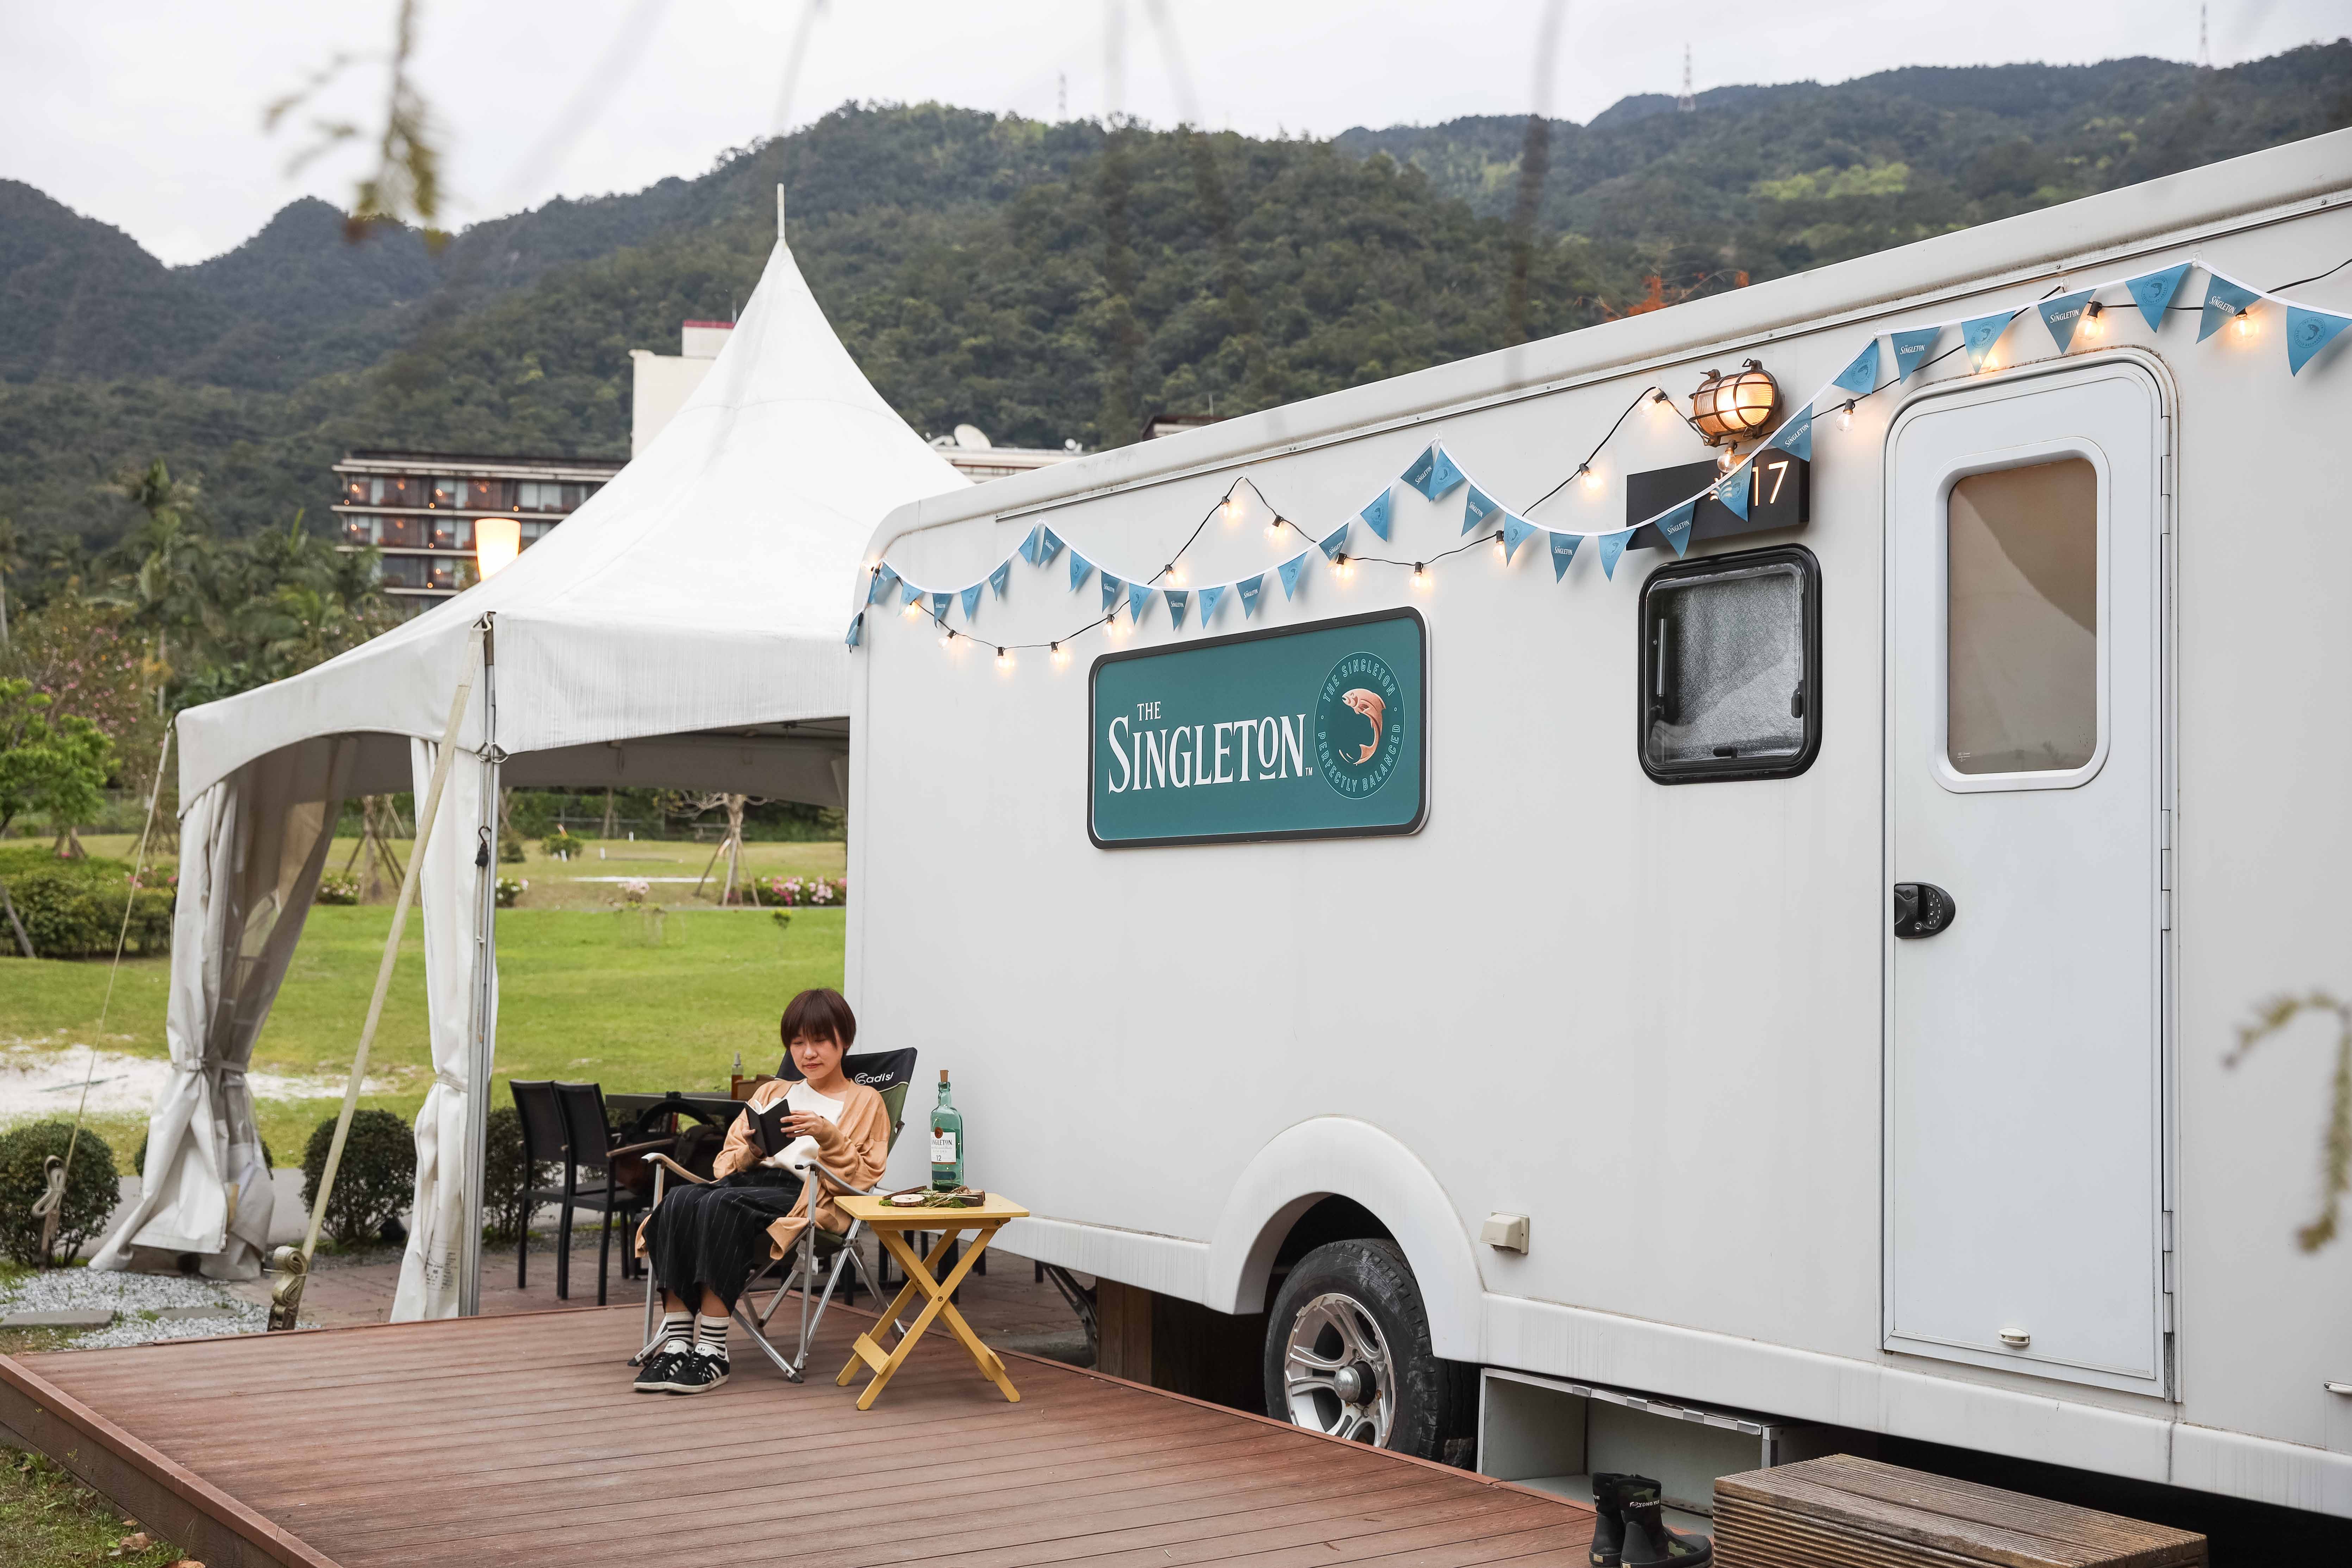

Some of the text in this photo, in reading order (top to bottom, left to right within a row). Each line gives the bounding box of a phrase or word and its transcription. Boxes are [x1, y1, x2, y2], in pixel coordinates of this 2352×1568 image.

[2209, 296, 2236, 314] SINGLETON
[2050, 309, 2079, 323] SINGLETON
[1900, 344, 1925, 355] SINGLETON
[1785, 423, 1809, 448] SINGLETON
[1415, 465, 1432, 485] SINGLETON
[1752, 460, 1789, 506] 17
[1469, 501, 1484, 518] SINGLETON
[1667, 520, 1690, 535] SINGLETON
[1554, 546, 1573, 555] SINGLETON
[1323, 659, 1395, 702] THE SINGLETON
[1137, 701, 1161, 721] THE
[1108, 714, 1306, 794] SINGLETON
[1318, 724, 1400, 792] PERFECTLY BALANCED
